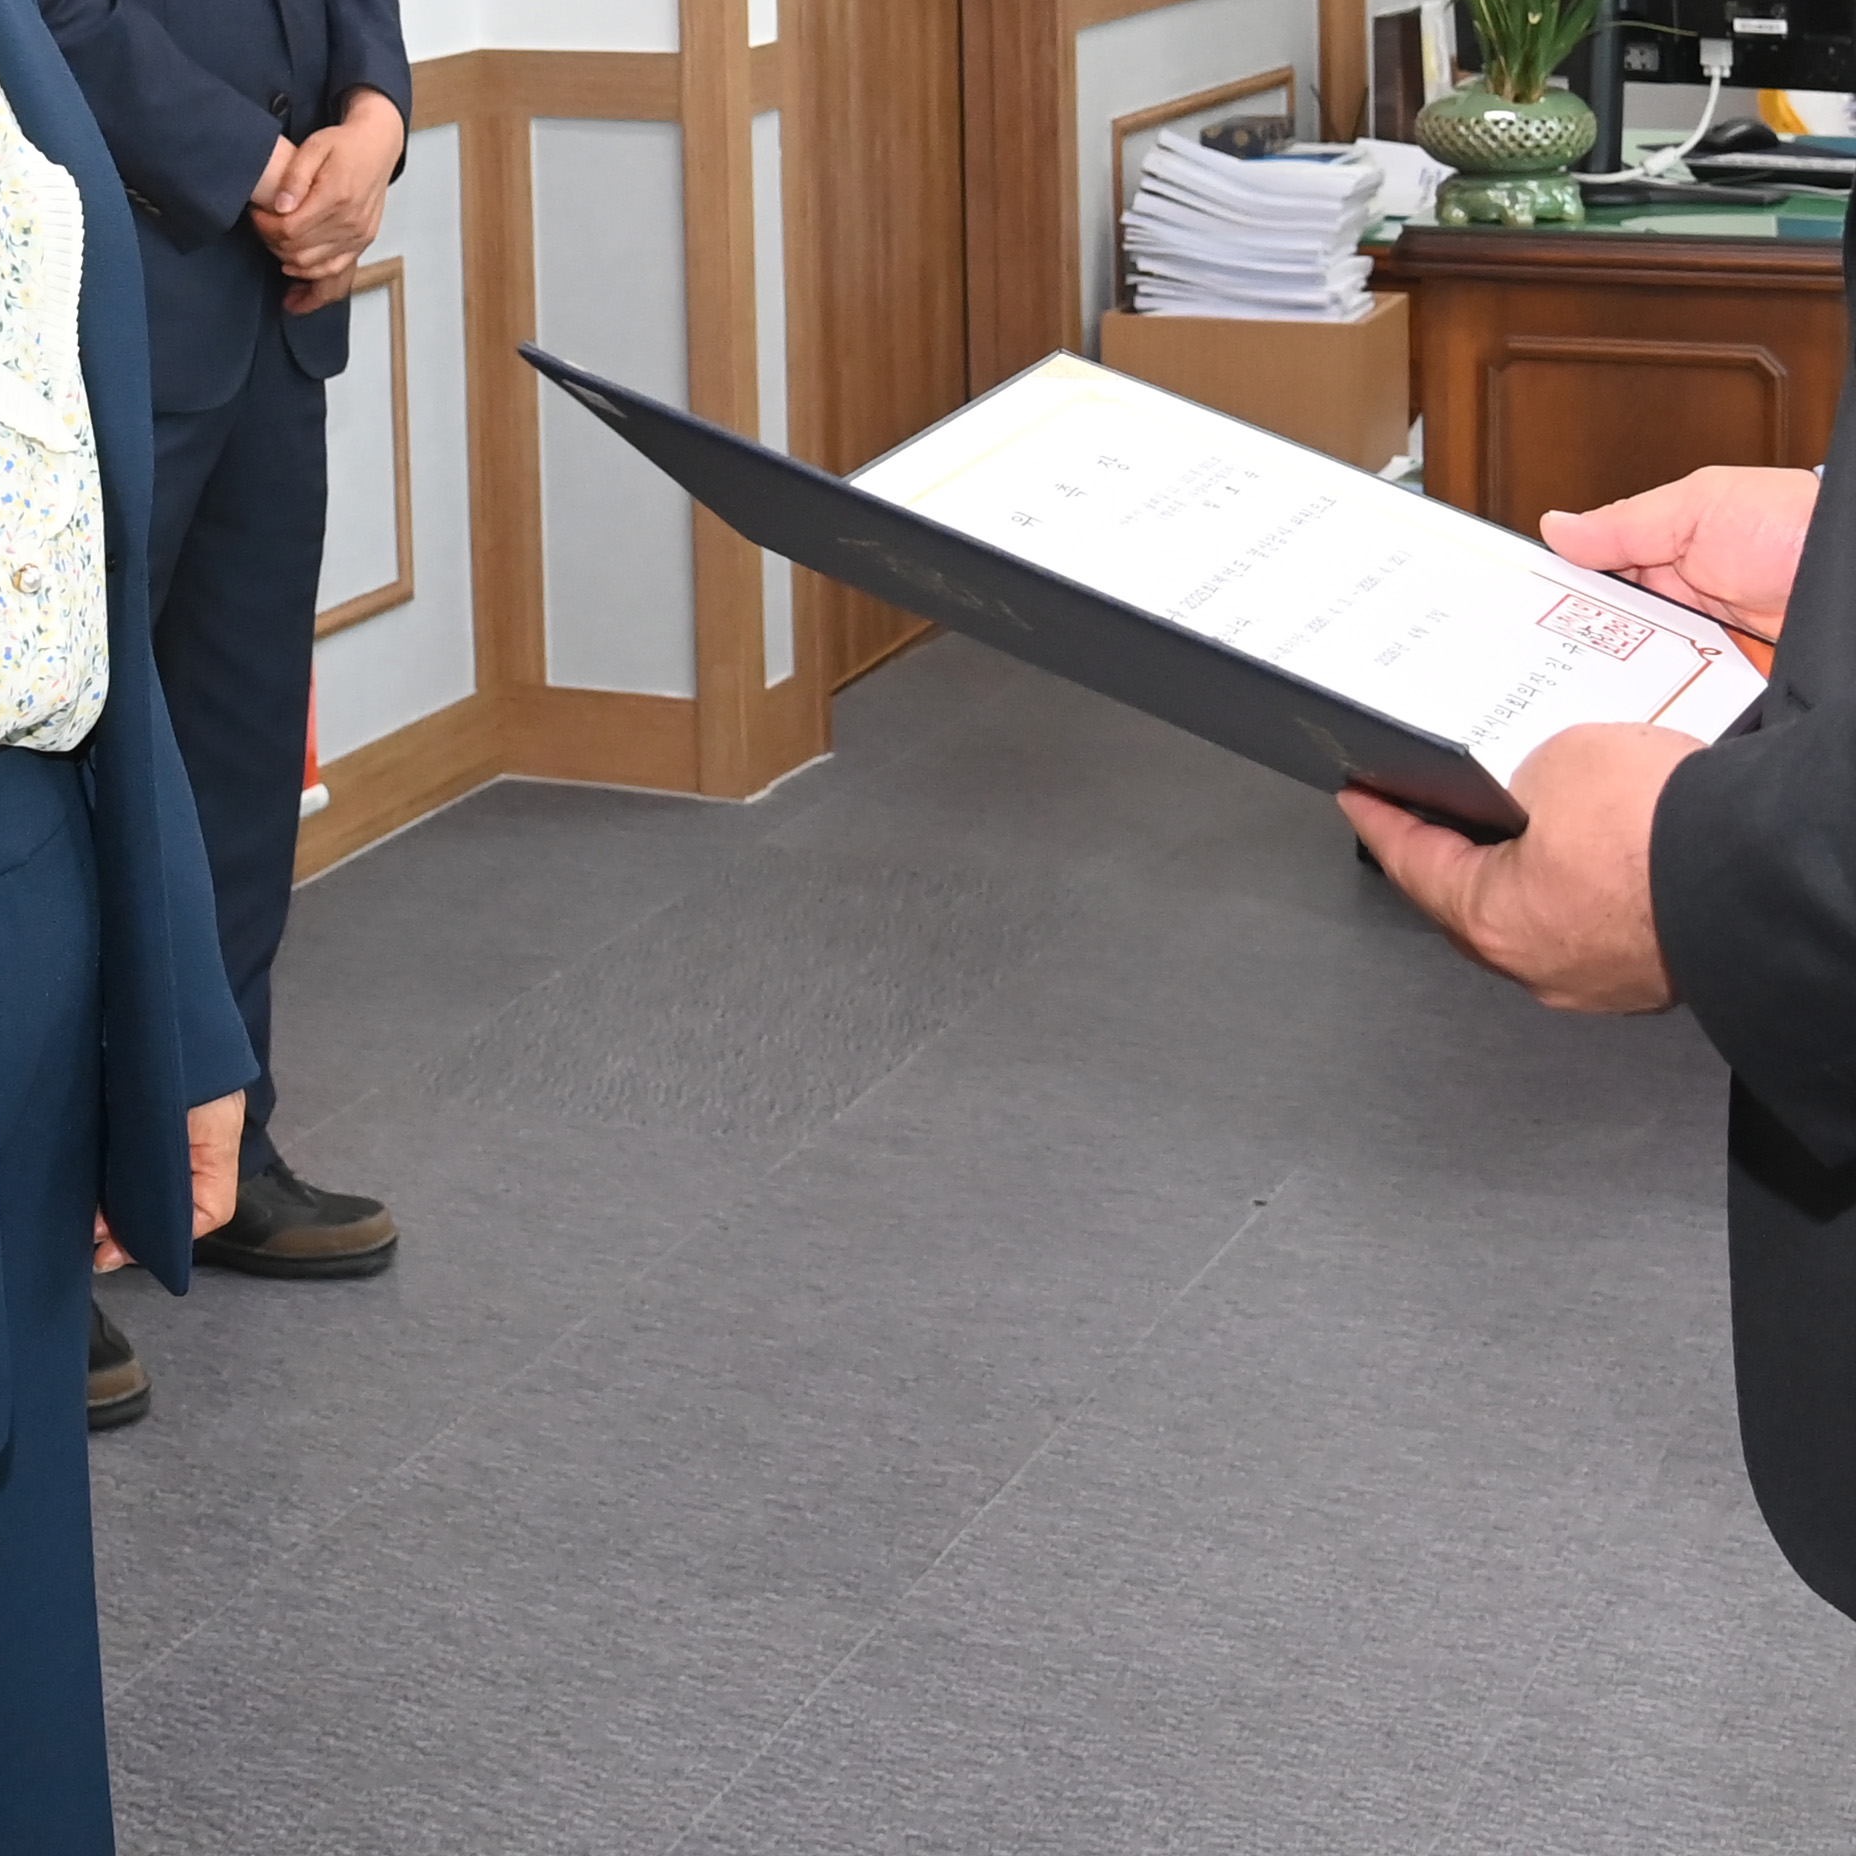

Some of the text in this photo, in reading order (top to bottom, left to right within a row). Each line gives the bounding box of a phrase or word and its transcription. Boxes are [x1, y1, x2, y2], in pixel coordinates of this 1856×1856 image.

[1012, 456, 1130, 527] 위 촉 장
[1545, 656, 1574, 671] 김
[1561, 642, 1585, 655] 규
